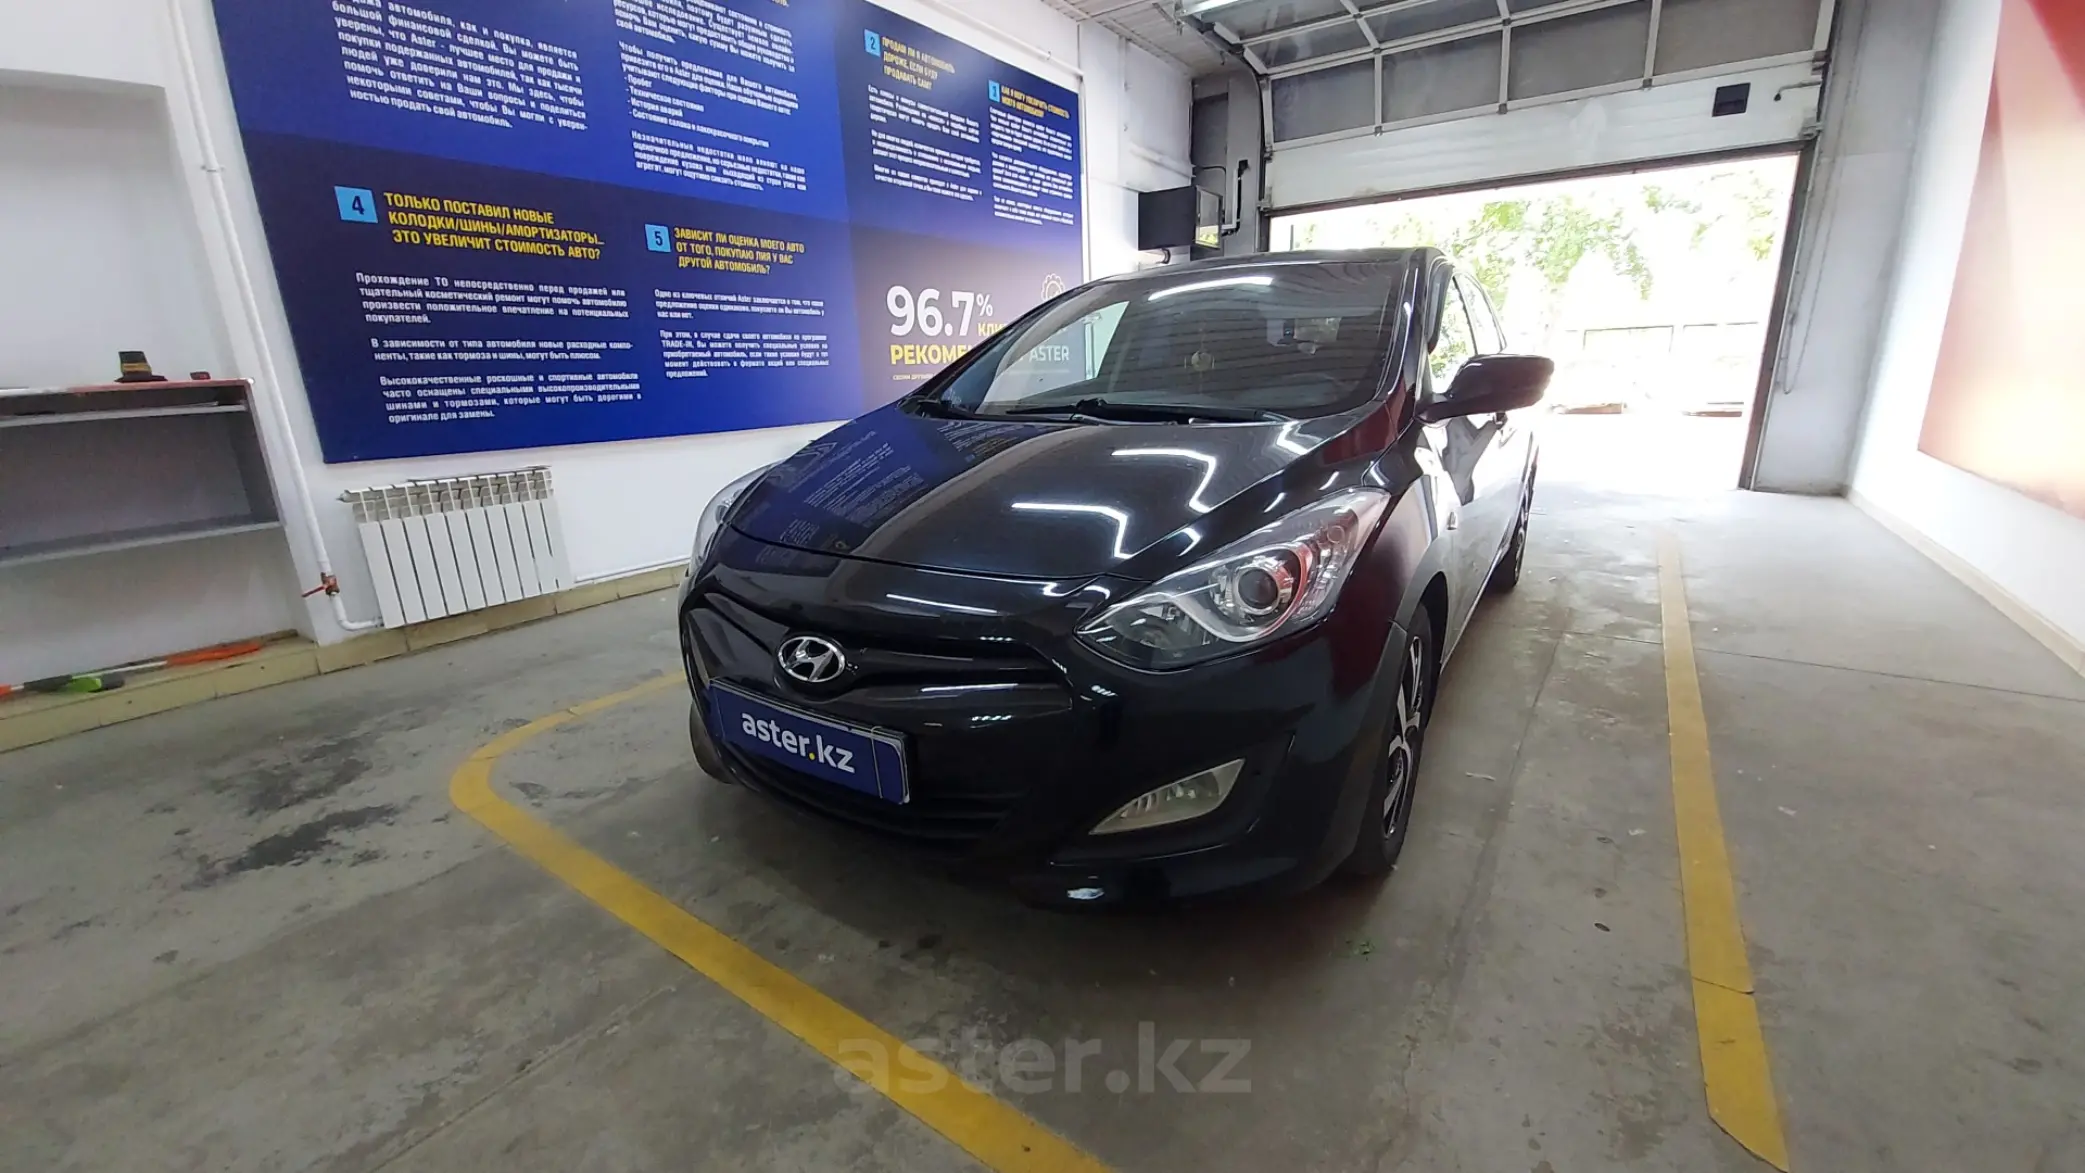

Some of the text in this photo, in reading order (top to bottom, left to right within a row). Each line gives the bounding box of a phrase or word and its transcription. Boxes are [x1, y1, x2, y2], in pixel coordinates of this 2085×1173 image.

[870, 36, 876, 50] 2
[352, 195, 364, 215] 4
[384, 191, 554, 225] ТОЛЬКО ПОСТАВИЛ НОВЫЕ
[391, 229, 602, 260] ЭТО УВЕЛИЧИТ СТОИМОСТЬ АВТО?
[654, 231, 662, 246] 5
[890, 344, 1070, 365] РЕКОМЕ ASTER
[741, 712, 855, 774] aster.kz
